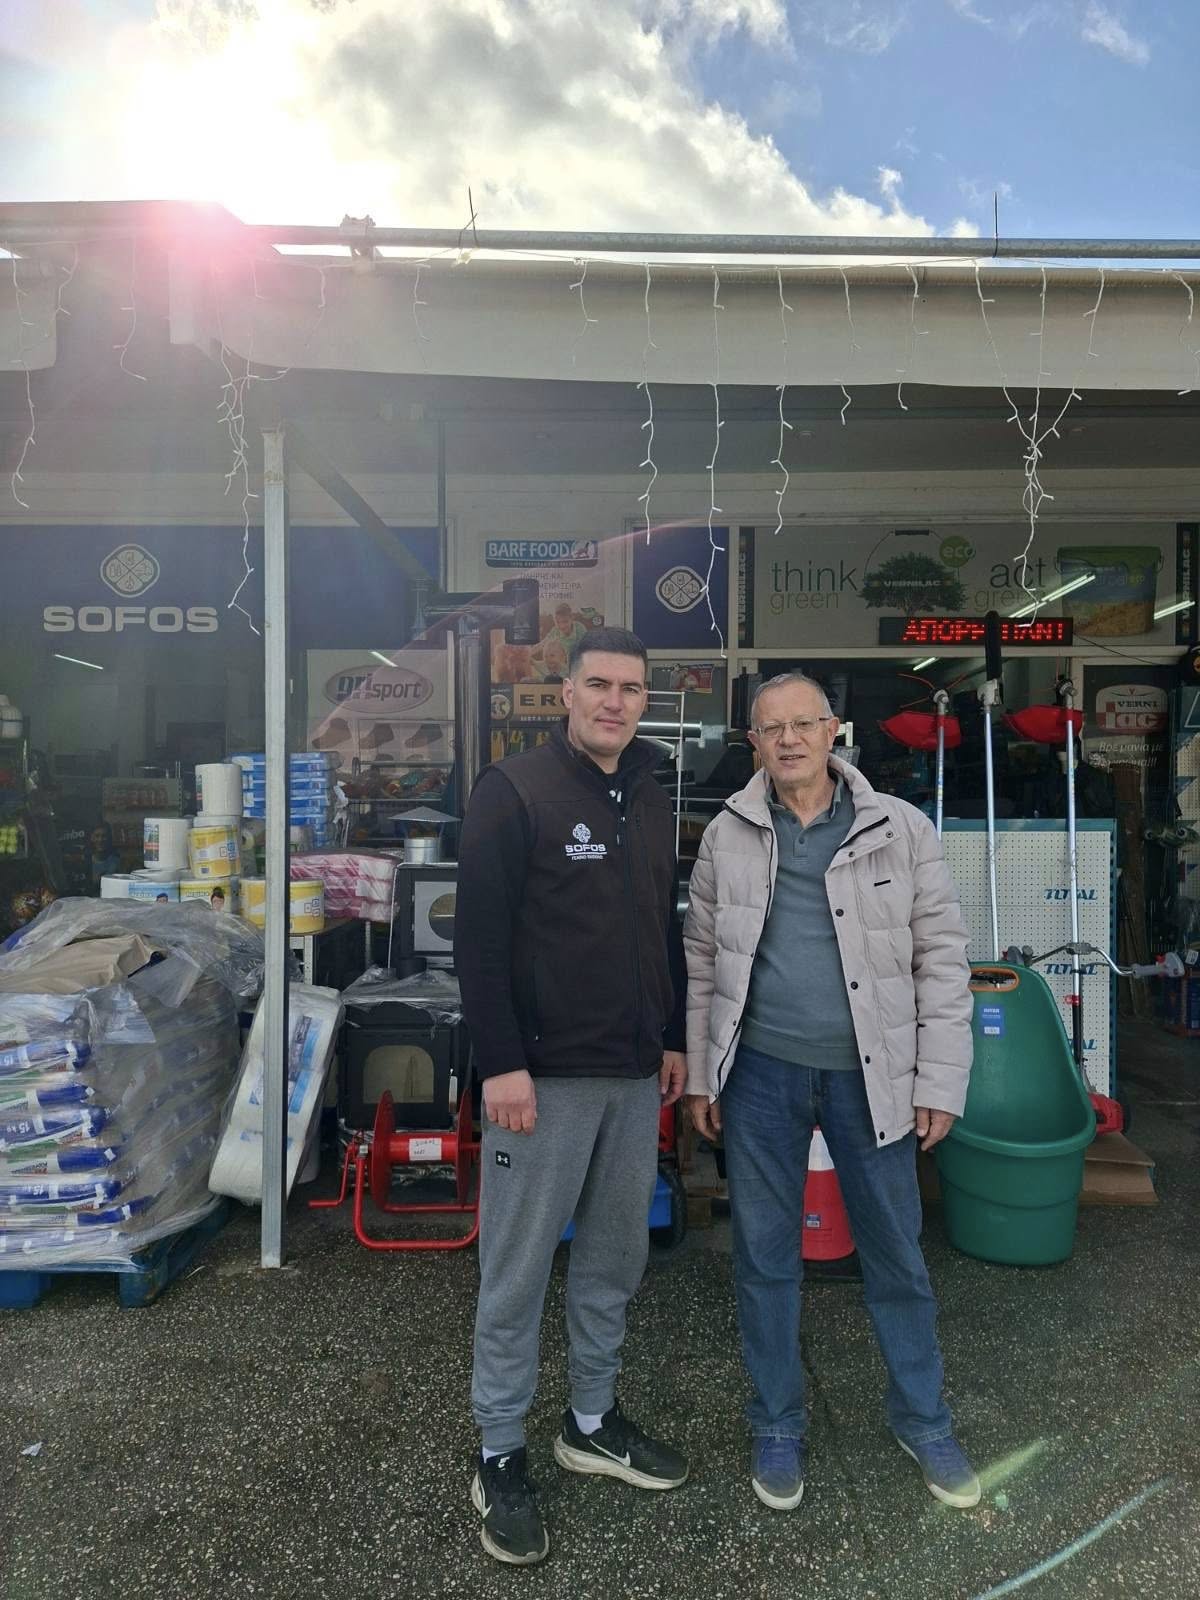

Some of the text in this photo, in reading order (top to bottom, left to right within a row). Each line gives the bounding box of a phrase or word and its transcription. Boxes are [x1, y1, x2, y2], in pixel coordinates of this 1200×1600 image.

[488, 542, 570, 558] BARF FOOD
[943, 546, 976, 560] eco
[771, 560, 858, 592] think
[883, 579, 943, 587] VERNILAC
[990, 557, 1047, 588] act
[769, 592, 840, 615] green
[973, 589, 1045, 613] gre
[43, 606, 219, 633] SOFOS
[565, 844, 607, 853] SOFOS
